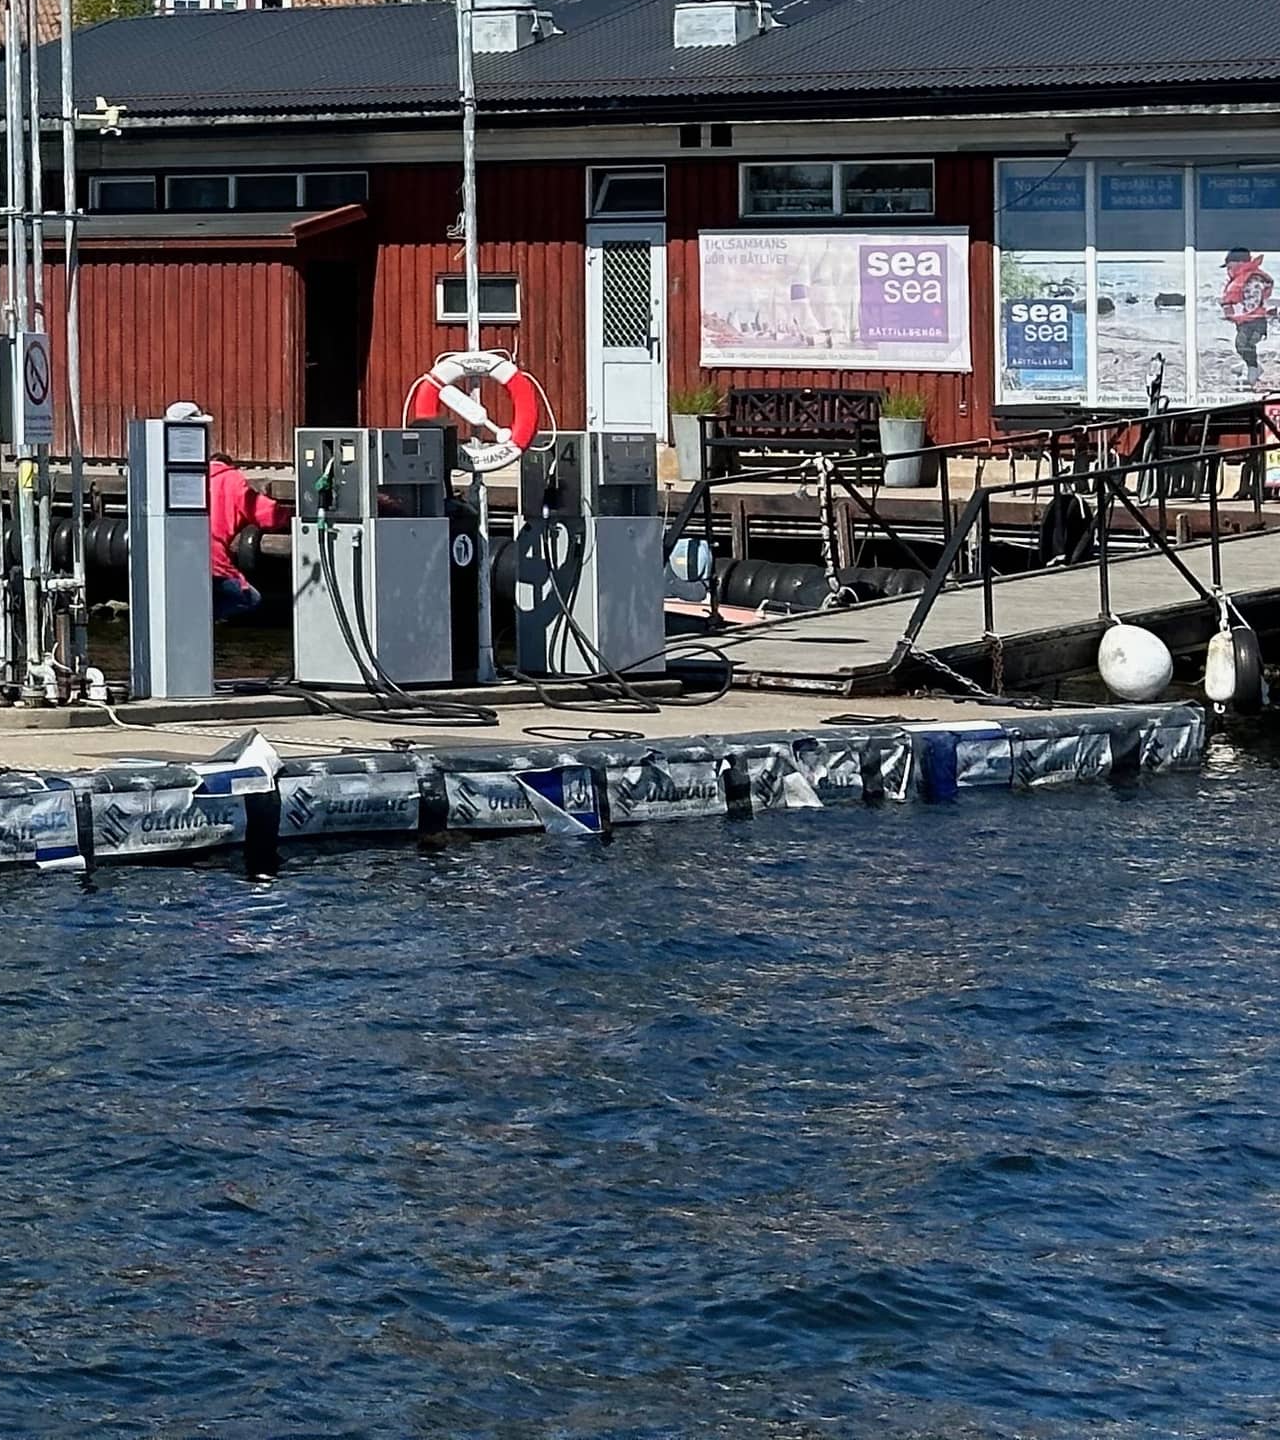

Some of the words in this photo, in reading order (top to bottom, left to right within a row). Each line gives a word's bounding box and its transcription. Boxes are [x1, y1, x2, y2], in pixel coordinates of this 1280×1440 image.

[867, 251, 943, 277] sea
[884, 279, 942, 303] sea
[1011, 303, 1068, 323] sea
[1024, 324, 1068, 342] sea
[560, 442, 576, 465] 4
